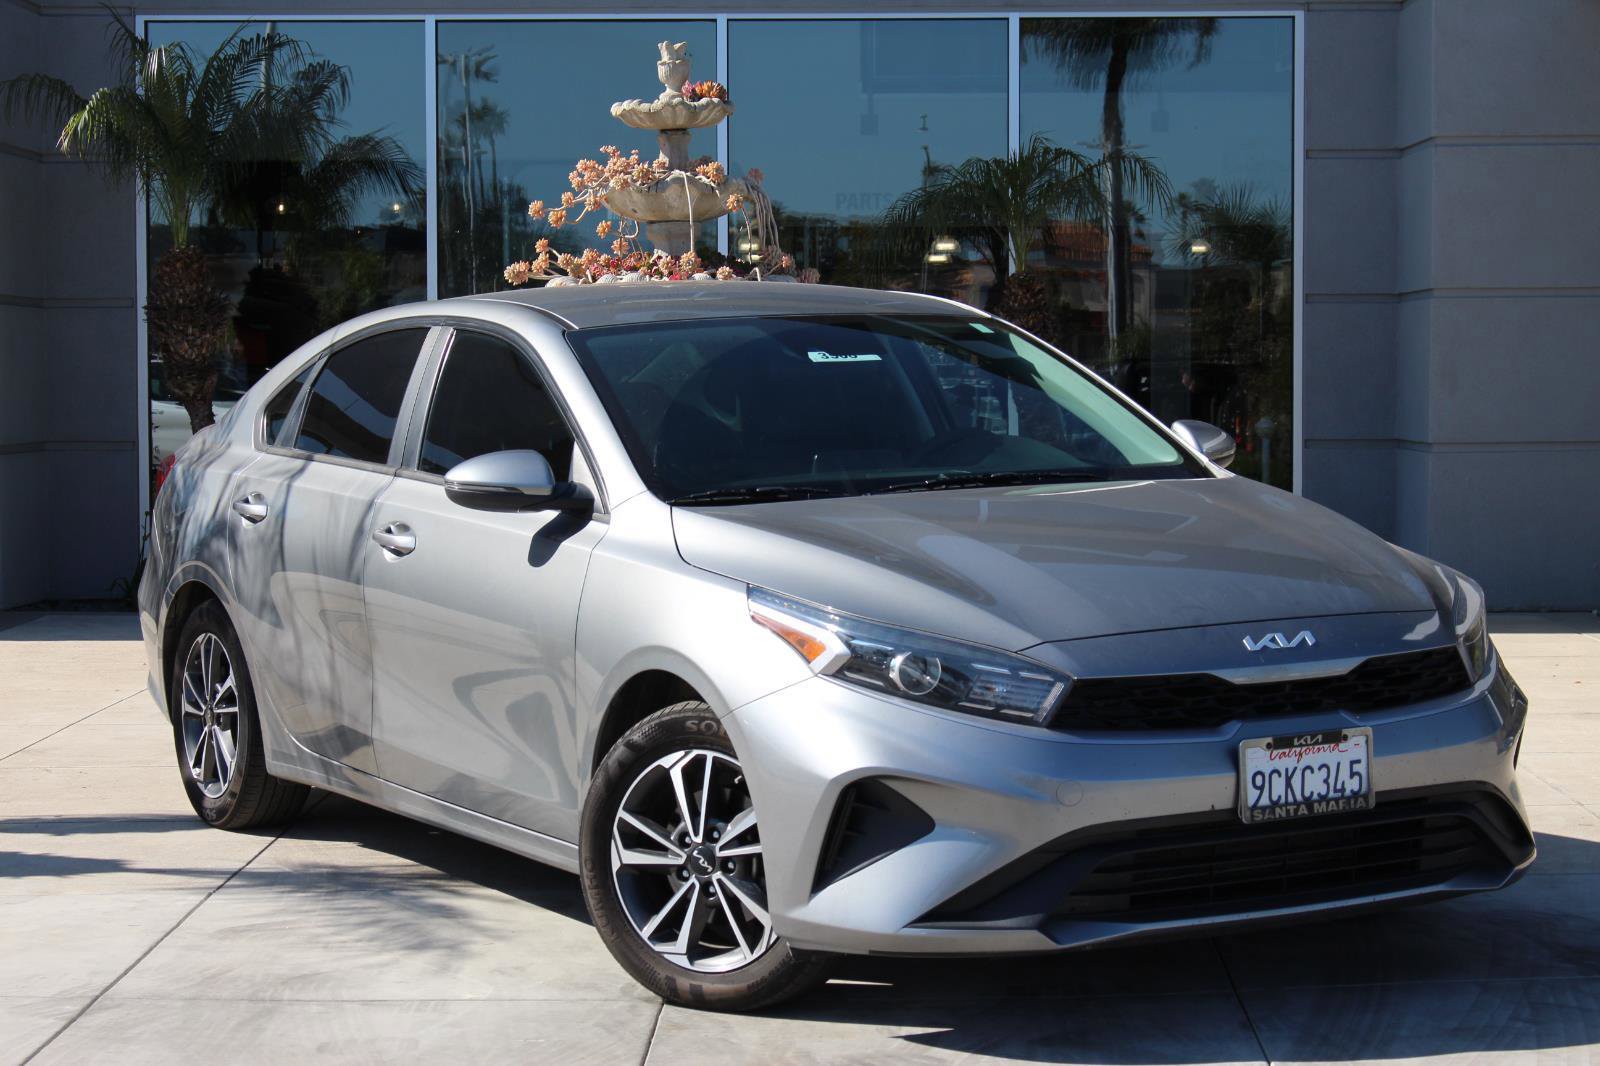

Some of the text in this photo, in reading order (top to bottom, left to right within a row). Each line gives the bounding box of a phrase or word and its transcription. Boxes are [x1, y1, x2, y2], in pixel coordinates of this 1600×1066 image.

[1242, 630, 1316, 651] KIA
[1293, 735, 1323, 746] KIA
[1270, 742, 1348, 763] California
[1251, 759, 1362, 809] 9CKC345
[1253, 805, 1311, 821] SANTA
